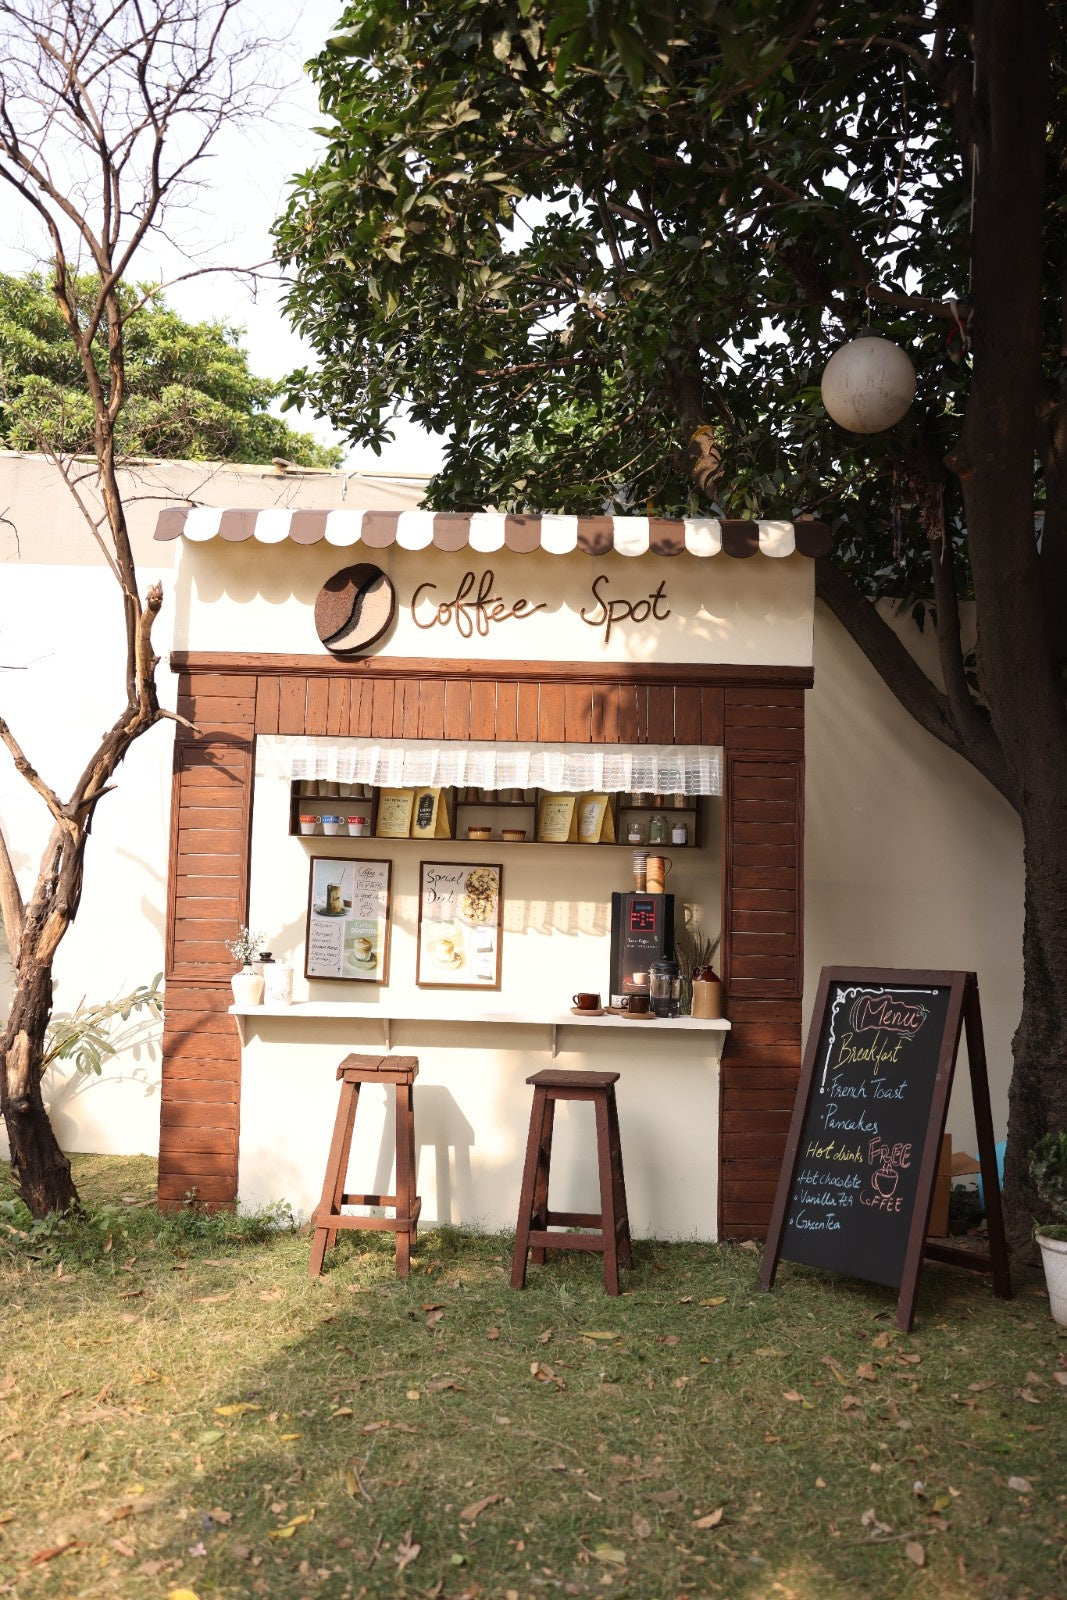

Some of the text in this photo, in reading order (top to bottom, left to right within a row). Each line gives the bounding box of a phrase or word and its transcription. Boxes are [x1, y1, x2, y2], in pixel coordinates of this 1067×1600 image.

[411, 569, 671, 644] Coffee Spot
[427, 869, 464, 888] Special
[861, 1001, 919, 1028] Menu
[833, 1030, 903, 1076] Breakfast
[830, 1073, 908, 1099] French Toast
[824, 1103, 878, 1134] Pancakes
[806, 1140, 863, 1163] Hot drinks
[868, 1136, 912, 1168] FREE
[800, 1170, 819, 1185] Hot
[801, 1189, 836, 1206] Vanilla
[826, 1213, 841, 1230] Tea
